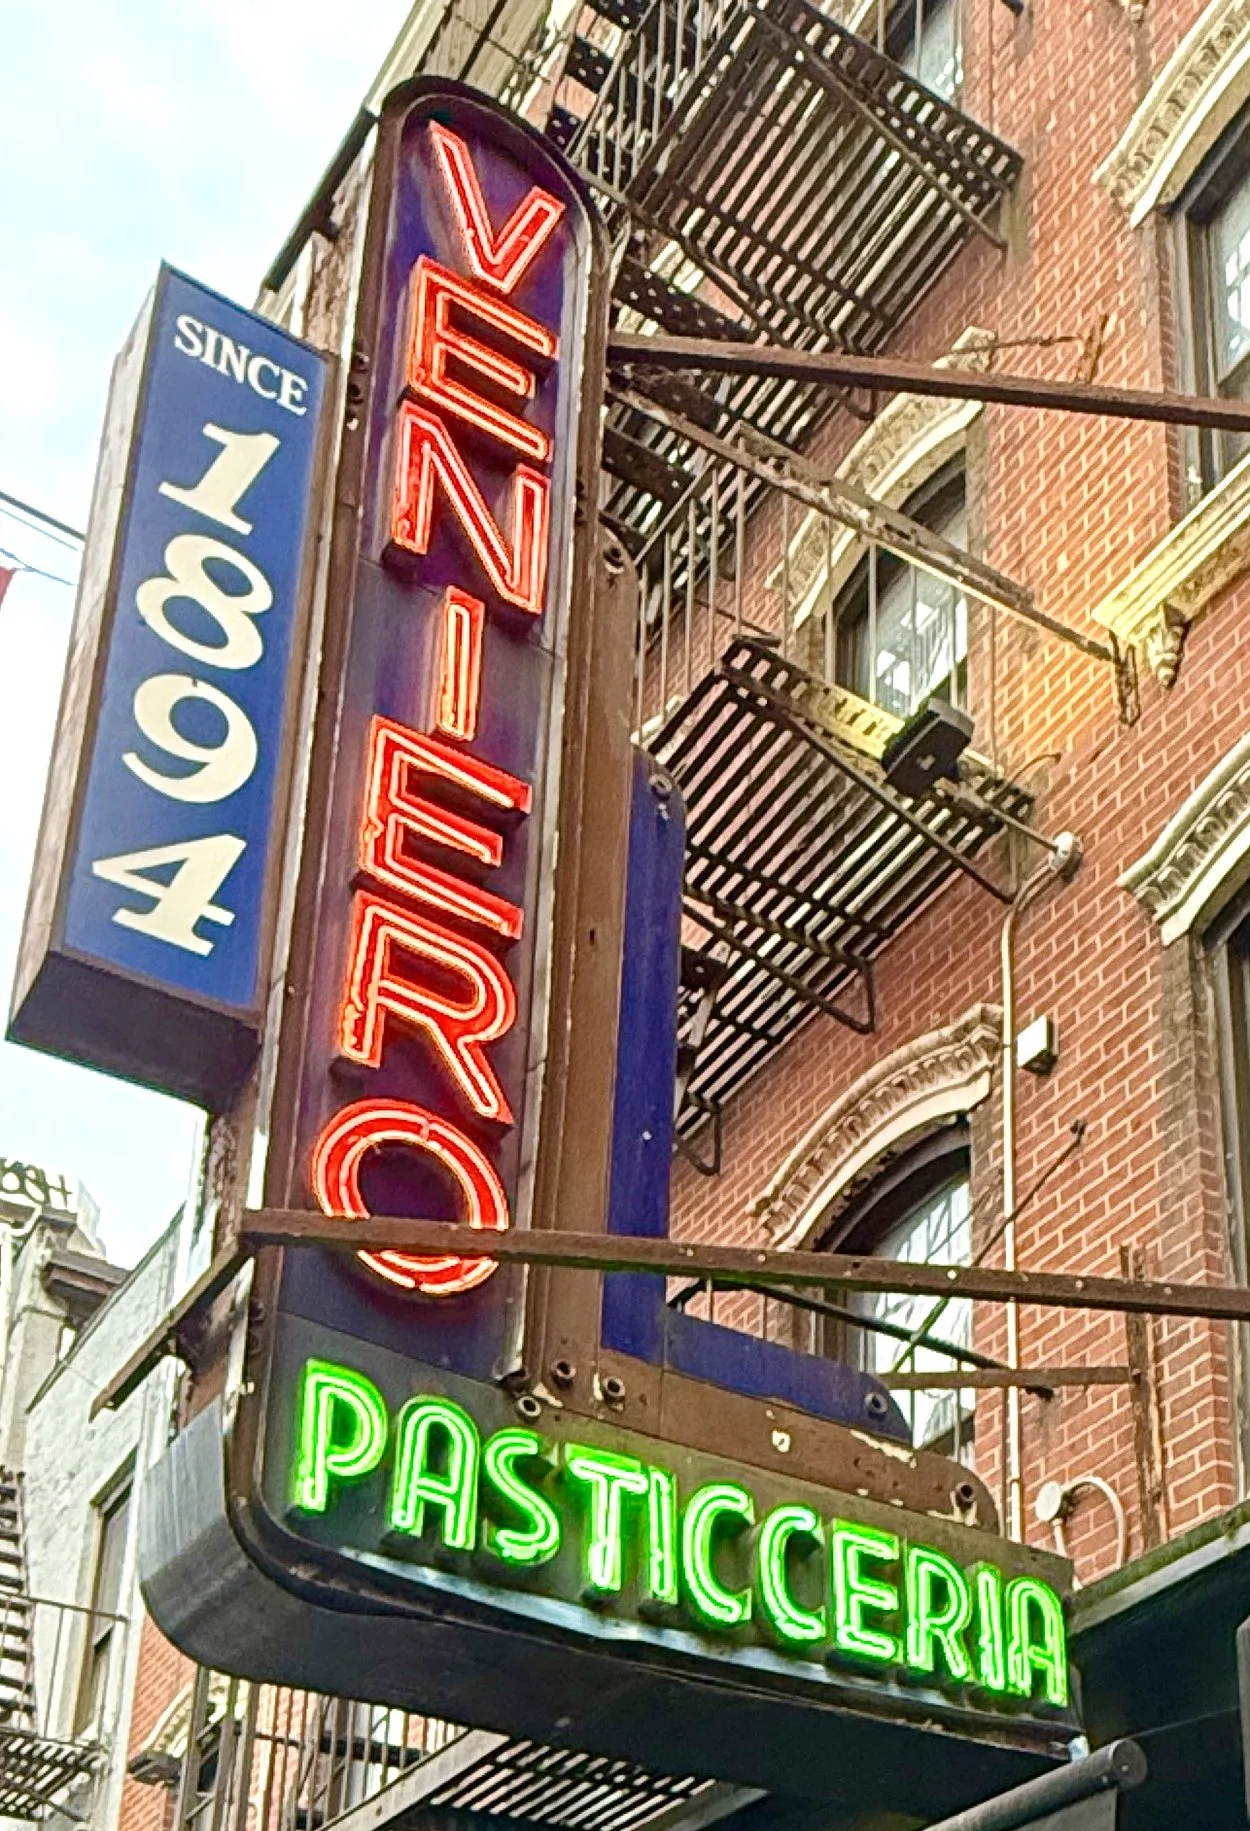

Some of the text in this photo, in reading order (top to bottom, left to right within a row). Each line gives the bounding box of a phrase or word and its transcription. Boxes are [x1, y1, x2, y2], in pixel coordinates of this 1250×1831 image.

[173, 313, 310, 417] SINCE
[91, 421, 281, 957] 1894
[310, 120, 564, 1297] VENIERO
[294, 1358, 1069, 1709] PASTICCERIA
